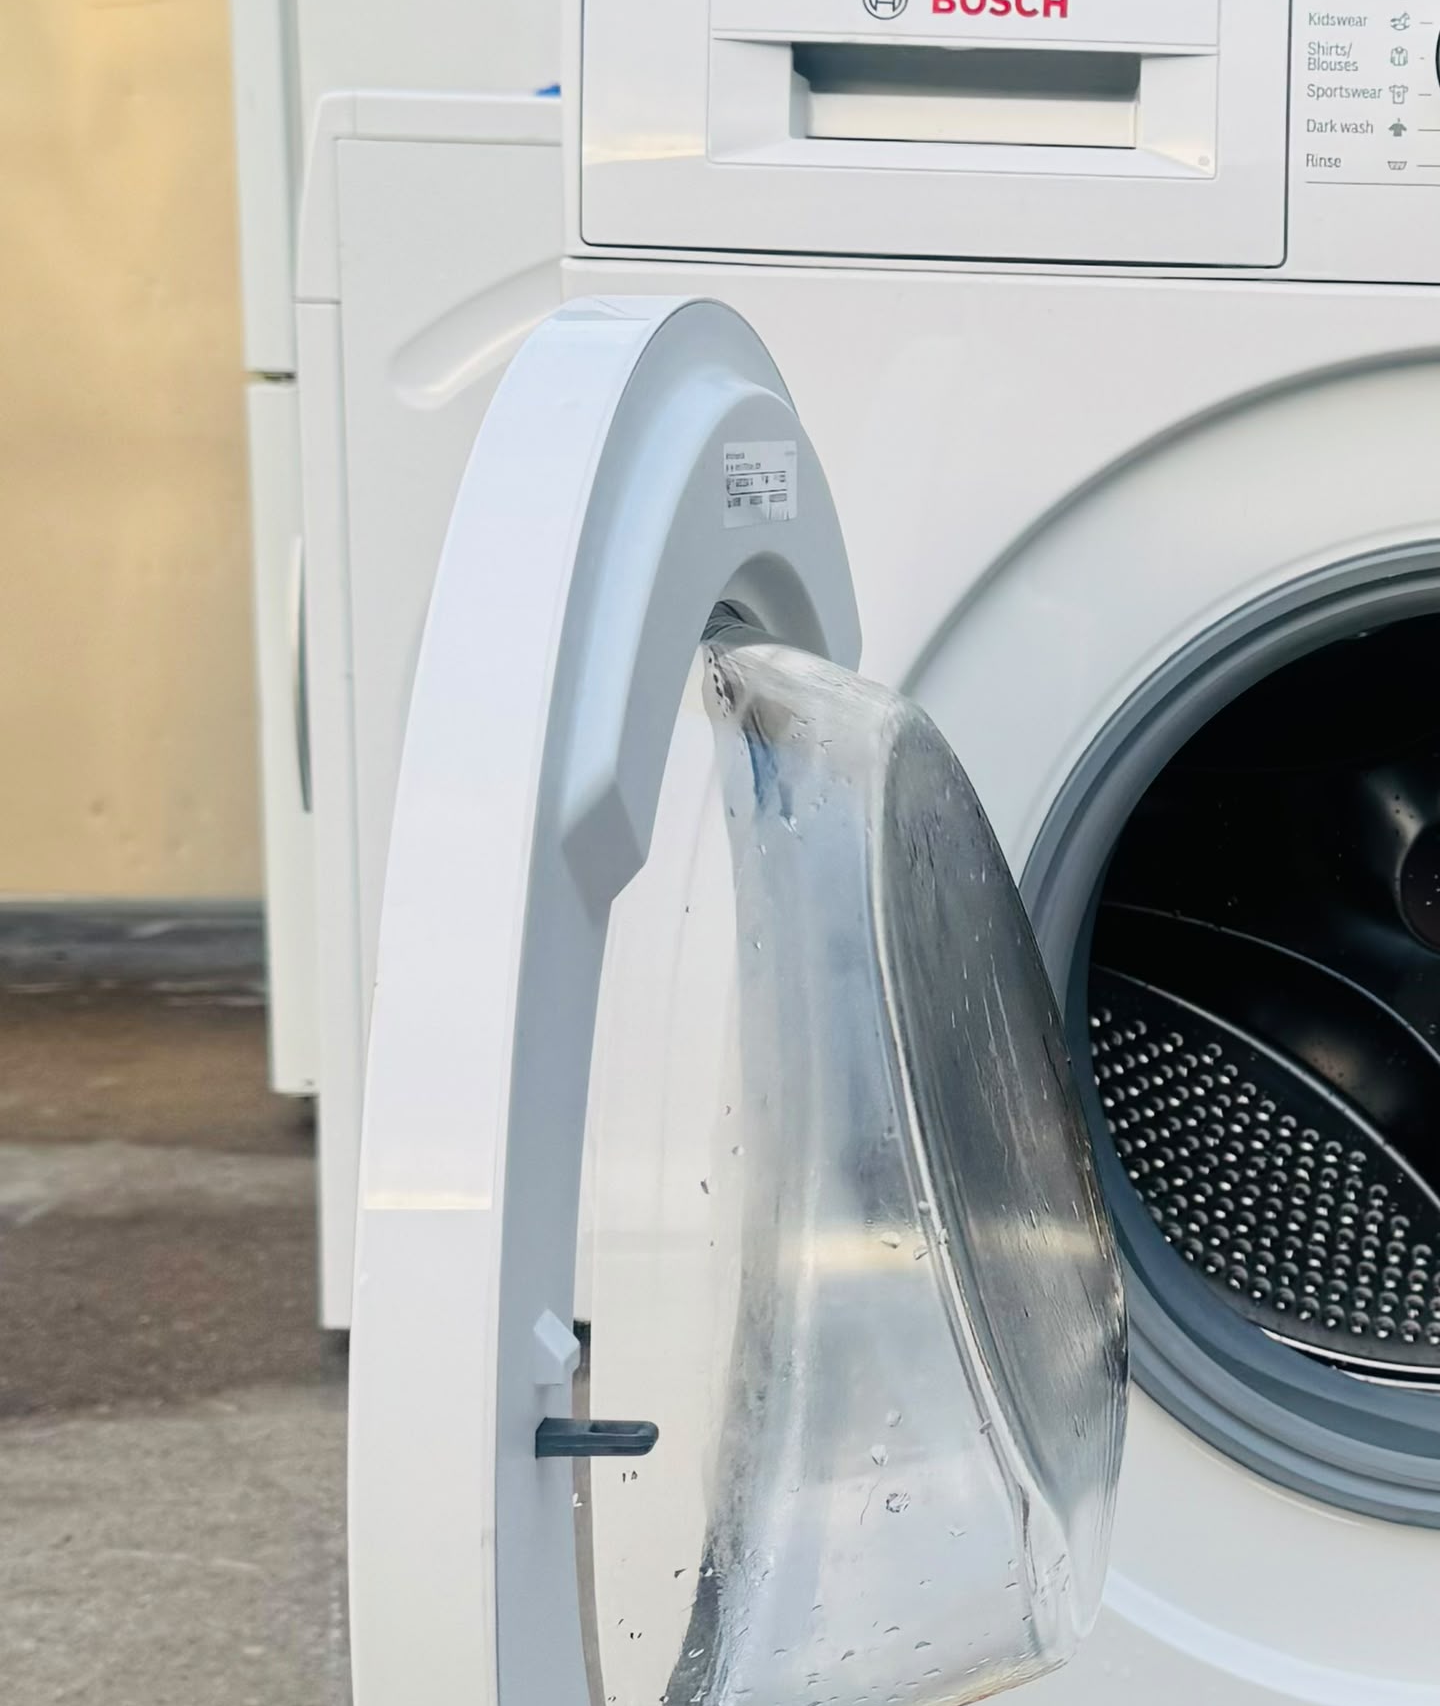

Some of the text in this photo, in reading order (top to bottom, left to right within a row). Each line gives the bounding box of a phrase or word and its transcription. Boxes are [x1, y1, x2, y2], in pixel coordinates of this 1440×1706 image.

[1308, 12, 1368, 28] Kidswear
[1307, 41, 1352, 59] Shirts/
[1307, 56, 1359, 72] Blouses
[1306, 83, 1383, 101] Sportswear
[1306, 118, 1374, 134] Dark wash
[1305, 153, 1342, 168] Rinse
